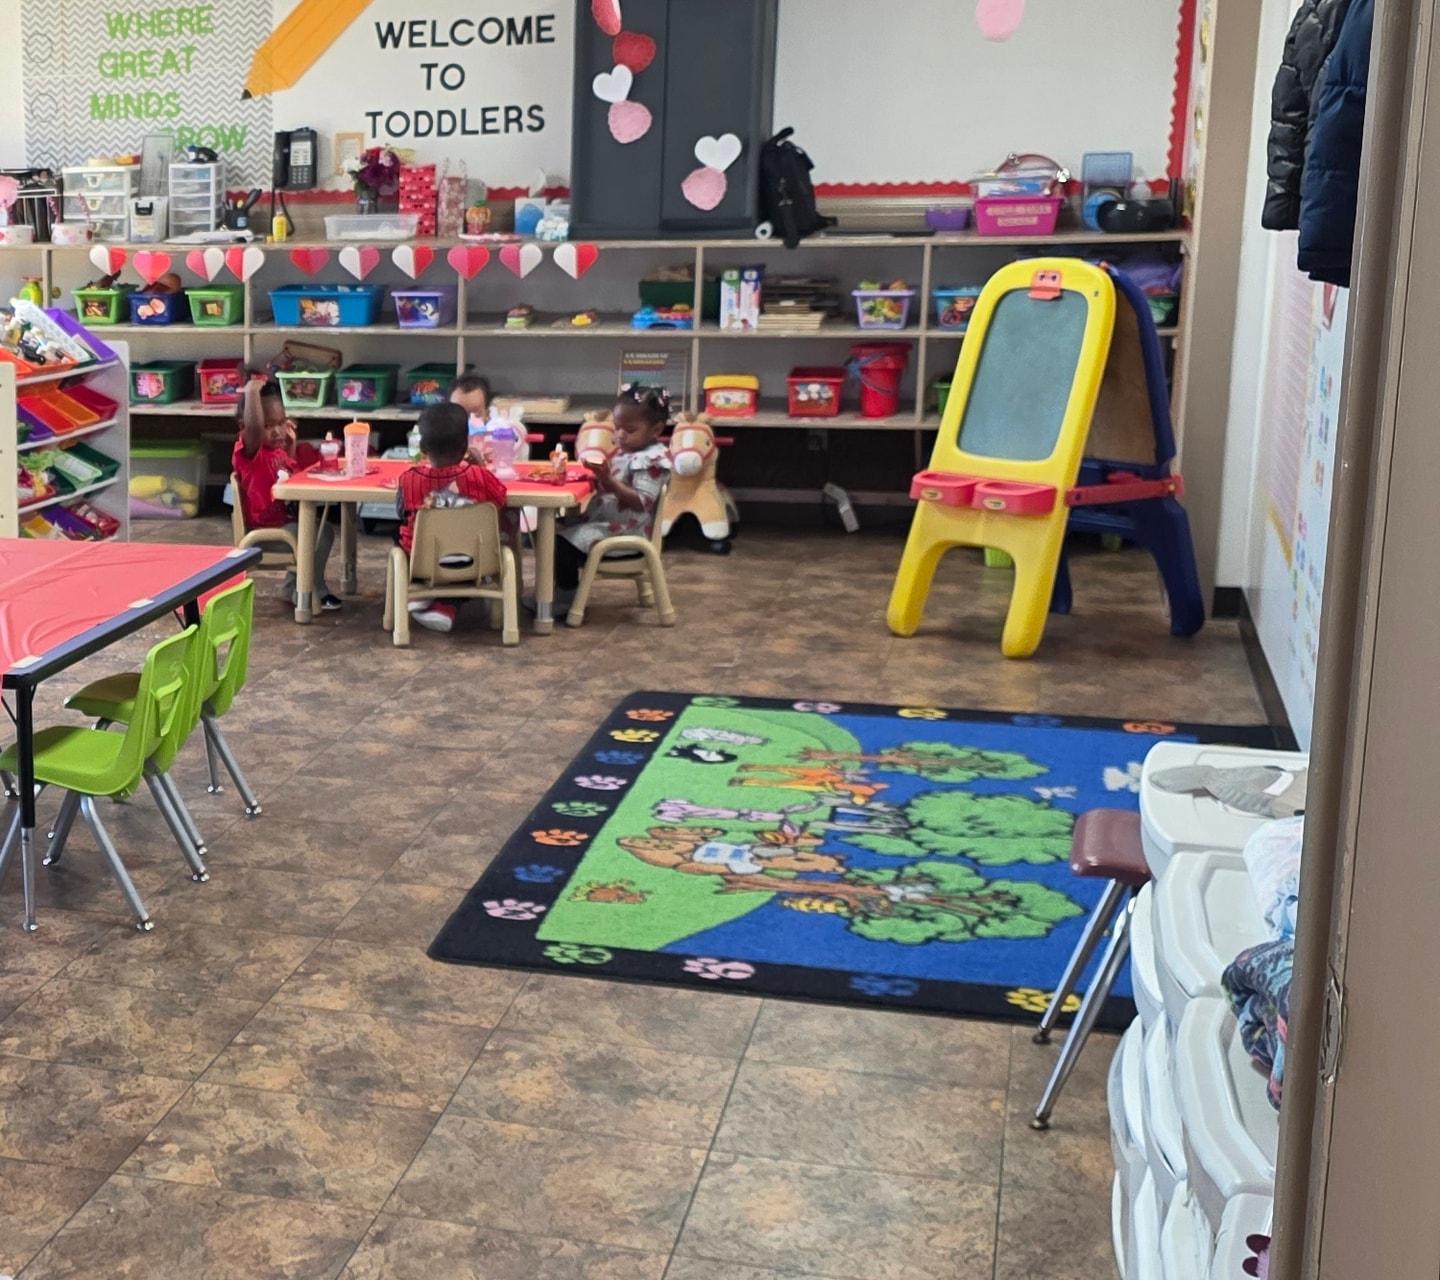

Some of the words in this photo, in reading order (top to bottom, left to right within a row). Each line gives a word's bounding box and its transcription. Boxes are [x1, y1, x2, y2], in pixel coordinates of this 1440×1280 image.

[106, 5, 214, 39] WHERE
[375, 14, 556, 49] WELCOME
[99, 45, 197, 79] GREAT
[420, 63, 466, 91] TO
[90, 91, 181, 121] MINDS
[365, 104, 545, 138] TODDLERS
[160, 124, 248, 153] ROW
